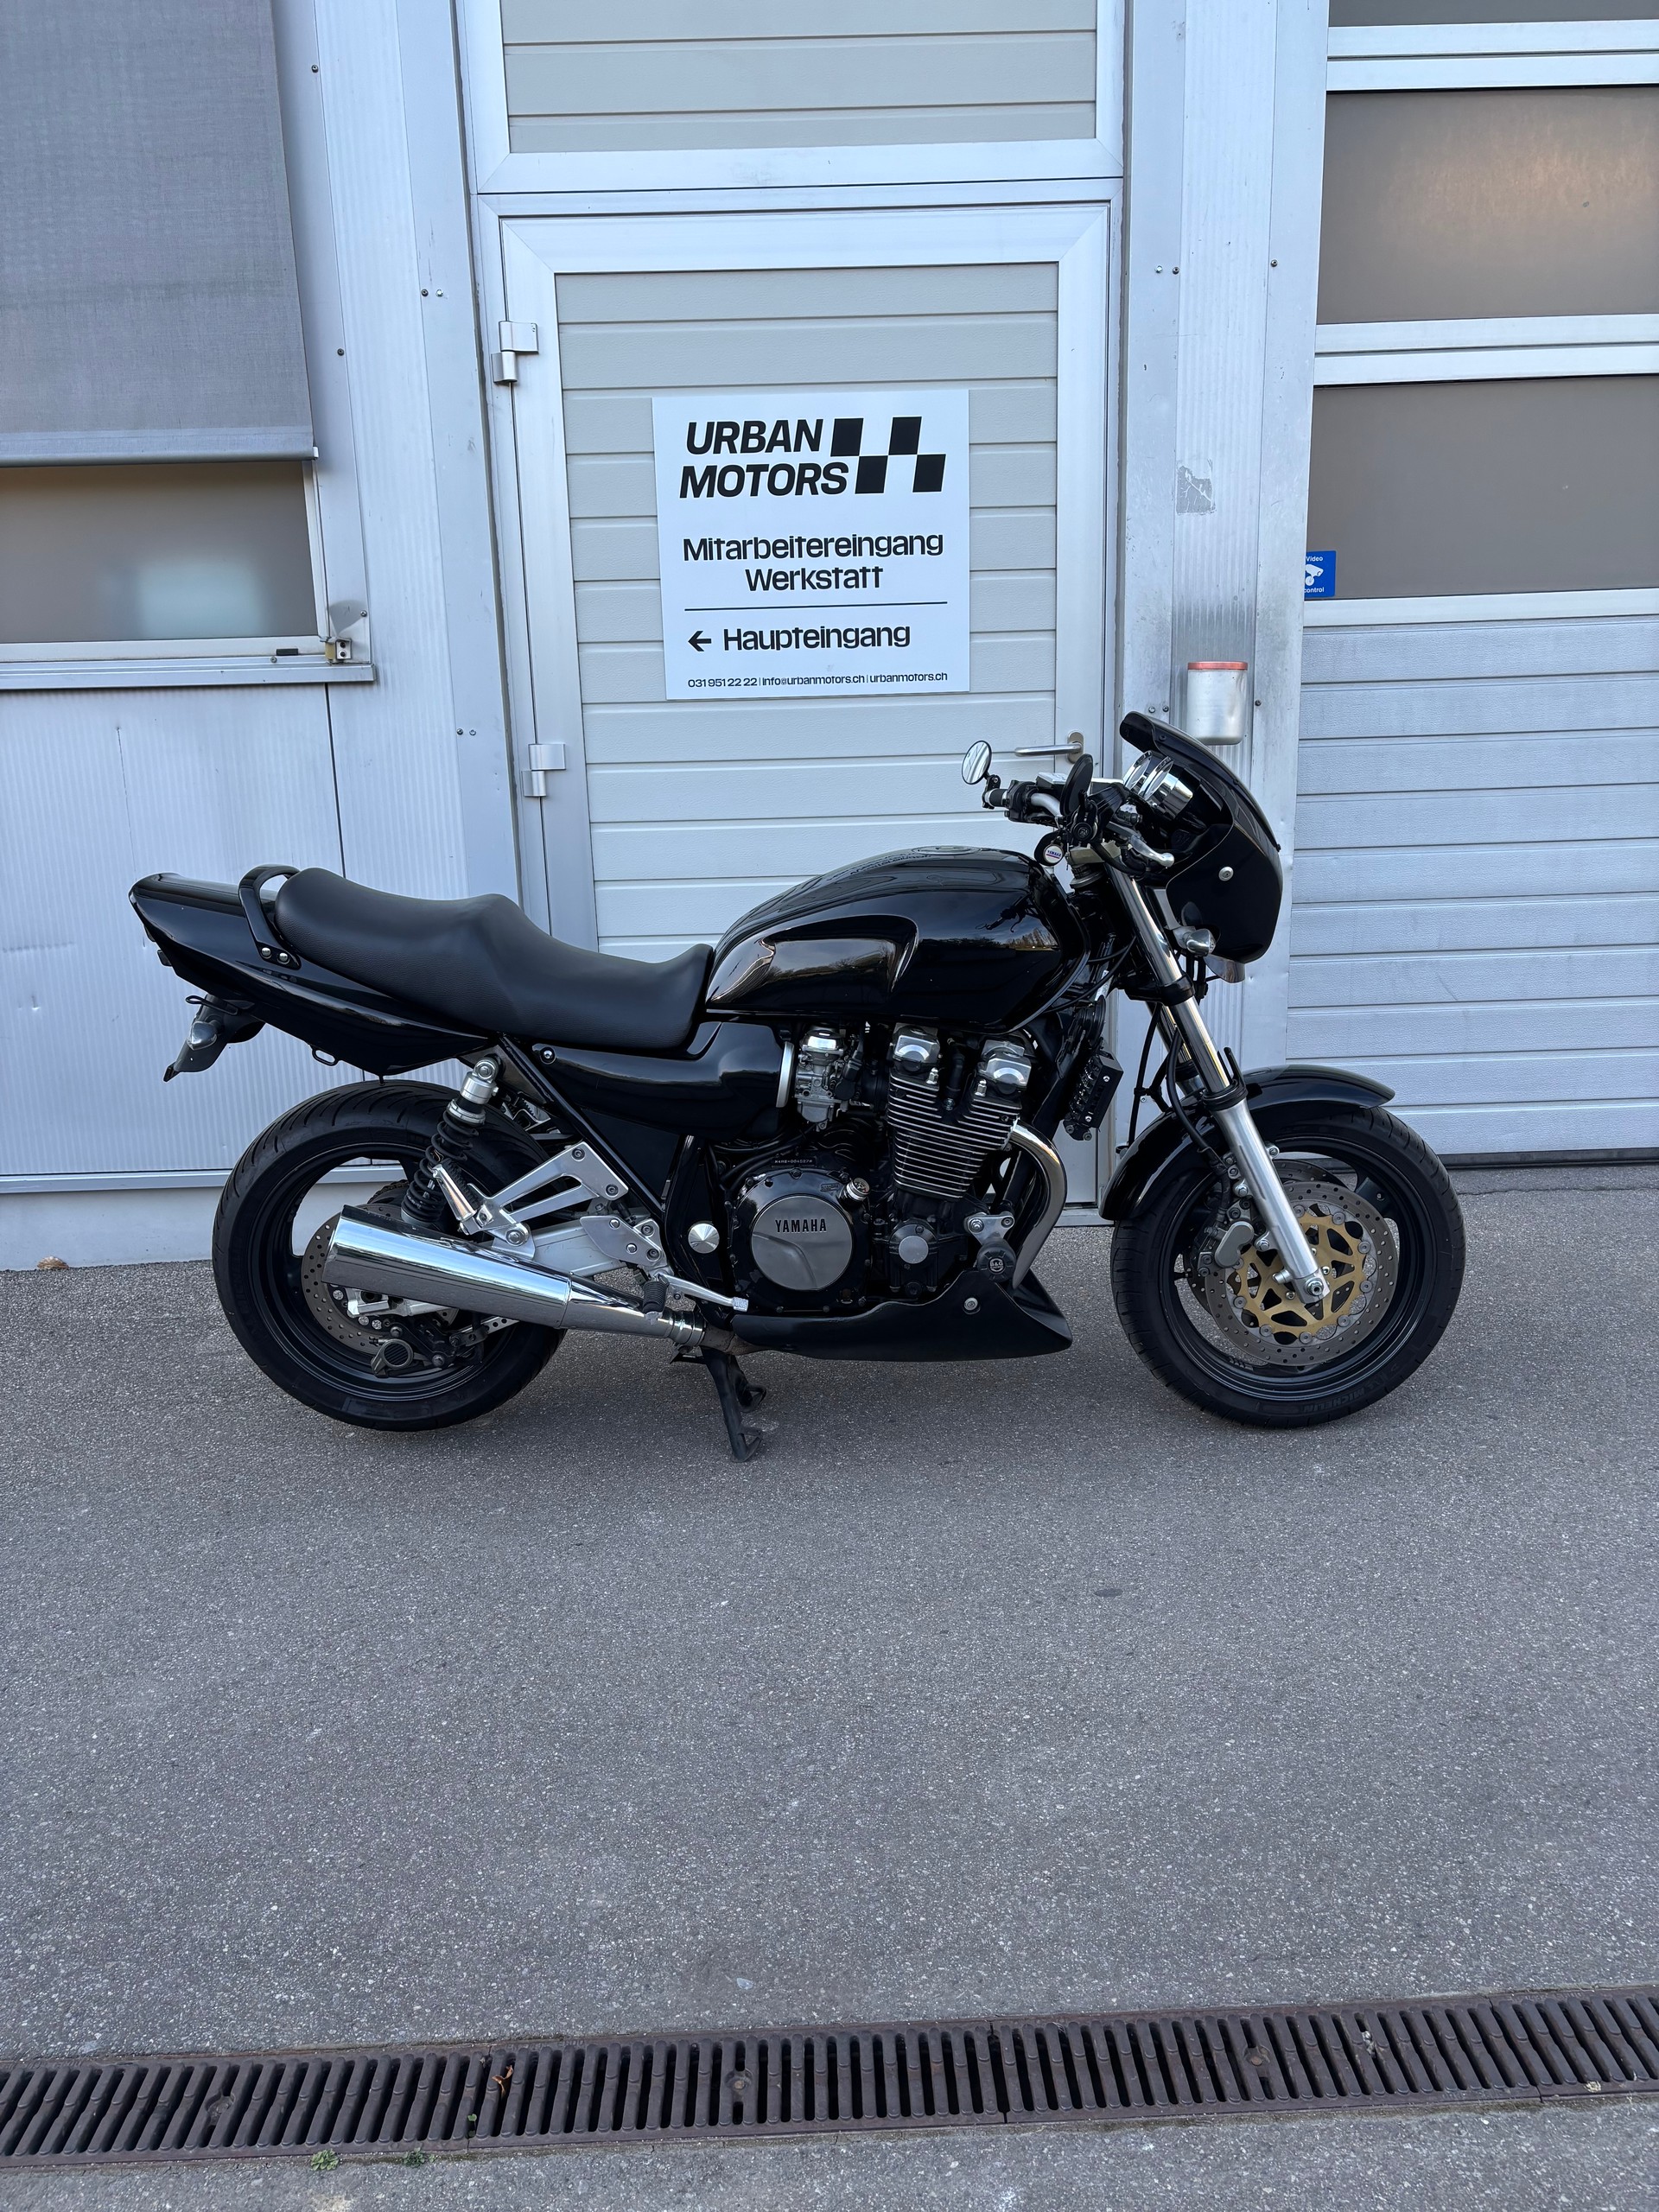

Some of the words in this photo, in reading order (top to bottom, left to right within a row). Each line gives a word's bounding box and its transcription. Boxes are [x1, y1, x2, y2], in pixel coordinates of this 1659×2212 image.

[686, 419, 823, 454] URBAN
[679, 462, 849, 499] MOTORS
[683, 533, 944, 562] Mitarbeitereingang
[745, 566, 883, 591] Werkstatt
[723, 626, 911, 651] Haupteingang
[743, 677, 758, 686] 22
[869, 672, 948, 683] urbanmotors.ch
[775, 1218, 827, 1233] YAMAHA
